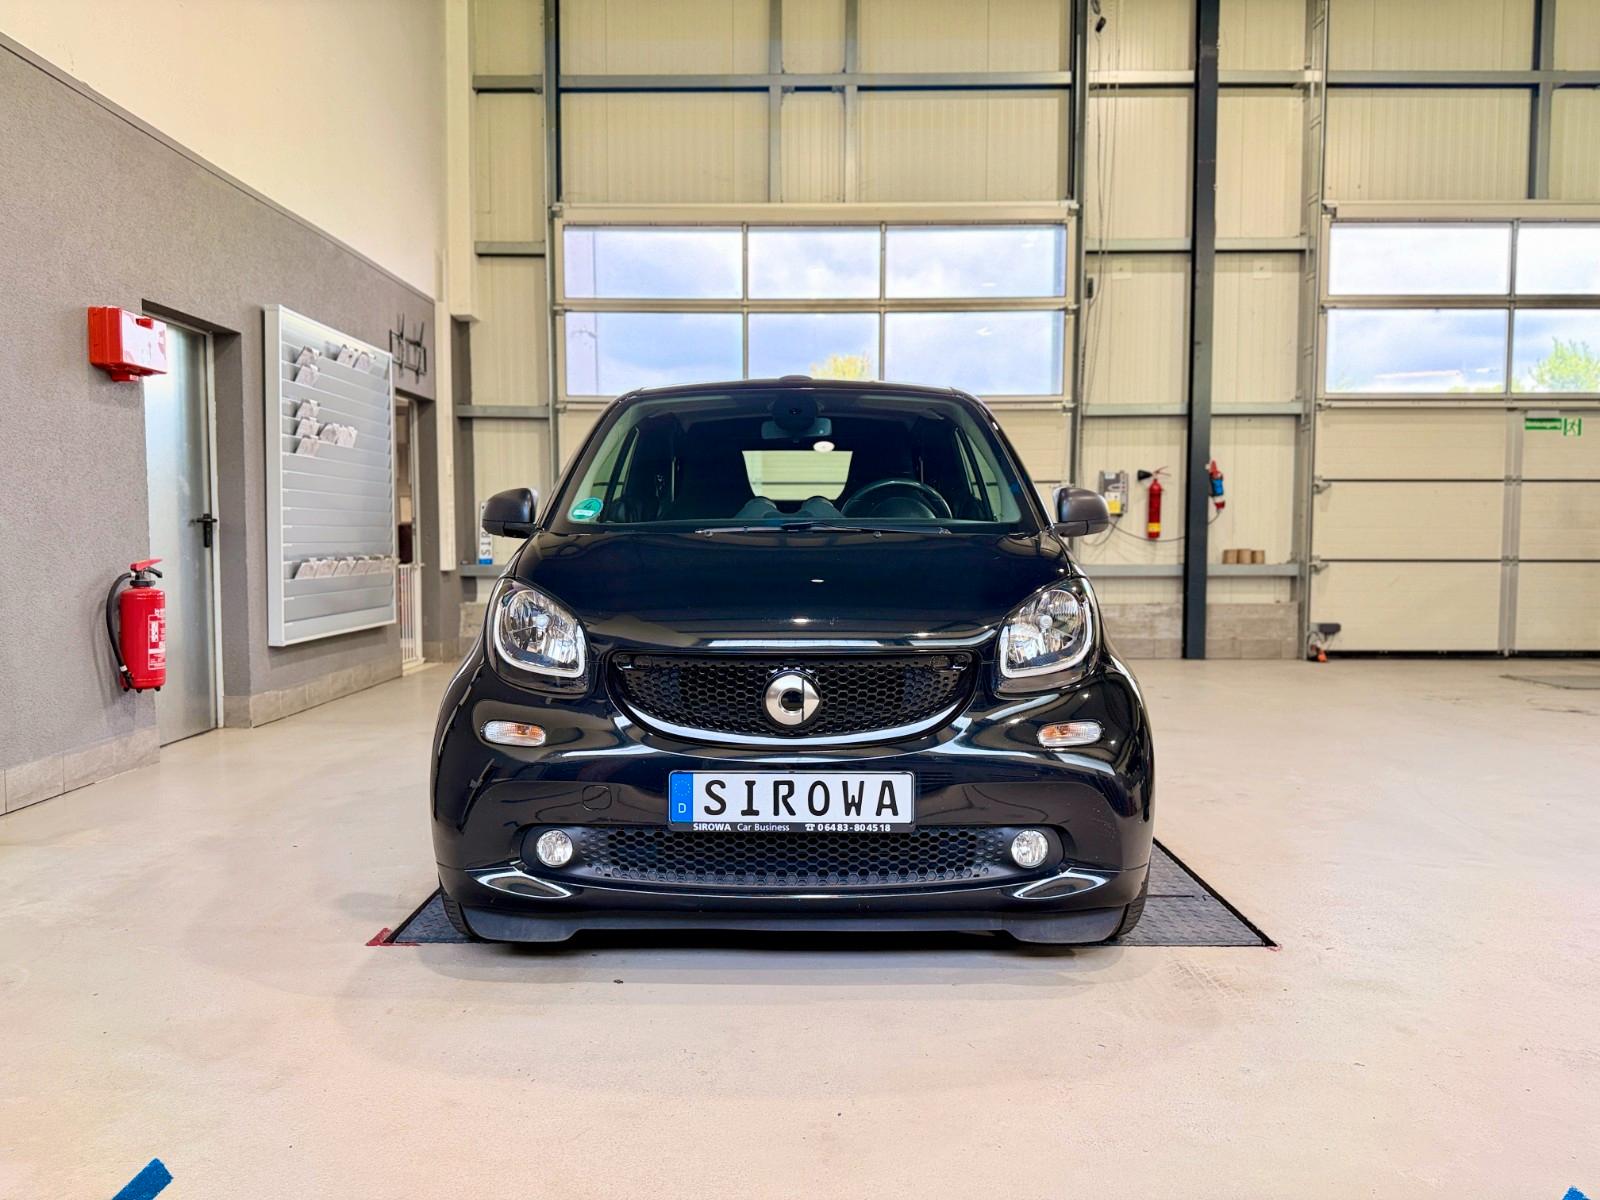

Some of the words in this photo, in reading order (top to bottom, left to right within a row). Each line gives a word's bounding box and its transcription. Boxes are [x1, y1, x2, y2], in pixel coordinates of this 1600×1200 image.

[704, 780, 899, 816] SIROWA
[678, 802, 687, 813] D
[693, 823, 731, 832] SIROWA
[737, 823, 752, 832] Car
[754, 823, 790, 832] Business
